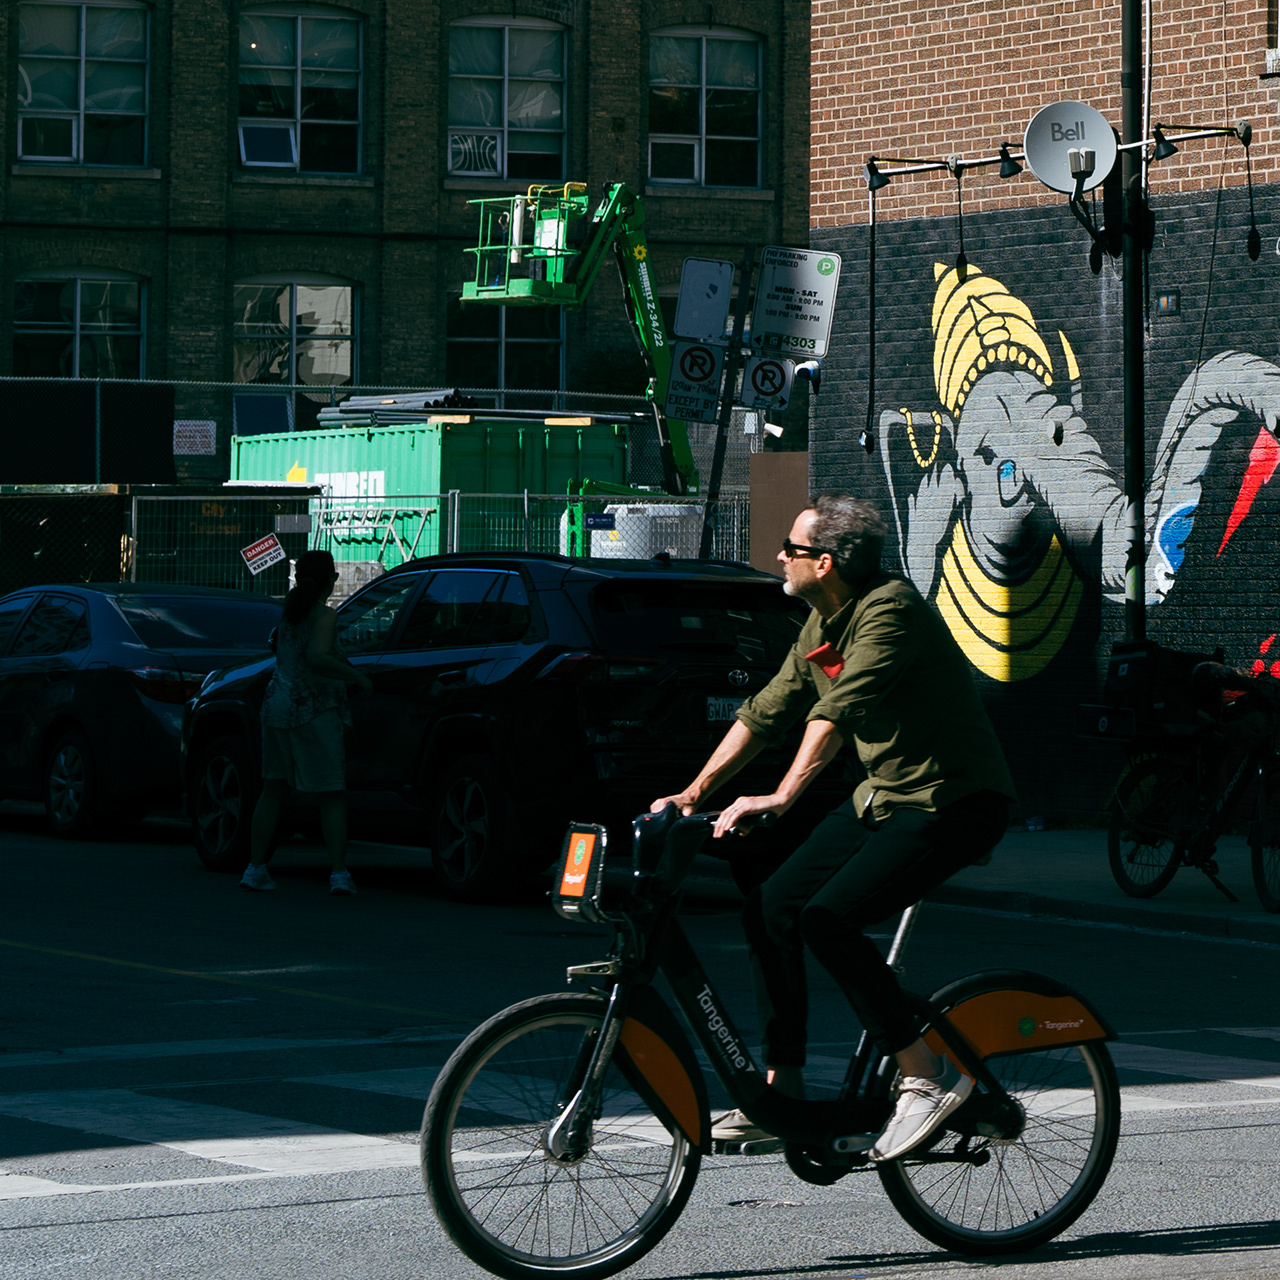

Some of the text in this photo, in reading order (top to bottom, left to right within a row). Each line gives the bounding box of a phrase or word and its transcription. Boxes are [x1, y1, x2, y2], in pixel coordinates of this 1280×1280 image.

[1051, 121, 1085, 141] Bell
[780, 251, 808, 261] PARKING
[765, 258, 798, 268] ENFORCED
[775, 286, 795, 295] MON
[785, 304, 802, 312] SUN
[783, 336, 816, 349] 4303
[668, 394, 715, 410] EXCEPT BY
[674, 407, 706, 420] PERMIT
[202, 503, 226, 518] City
[246, 539, 275, 558] DANGER
[252, 552, 282, 571] KEEP OUT
[697, 983, 746, 1069] Tangerine
[1044, 1020, 1080, 1030] Tangerine
